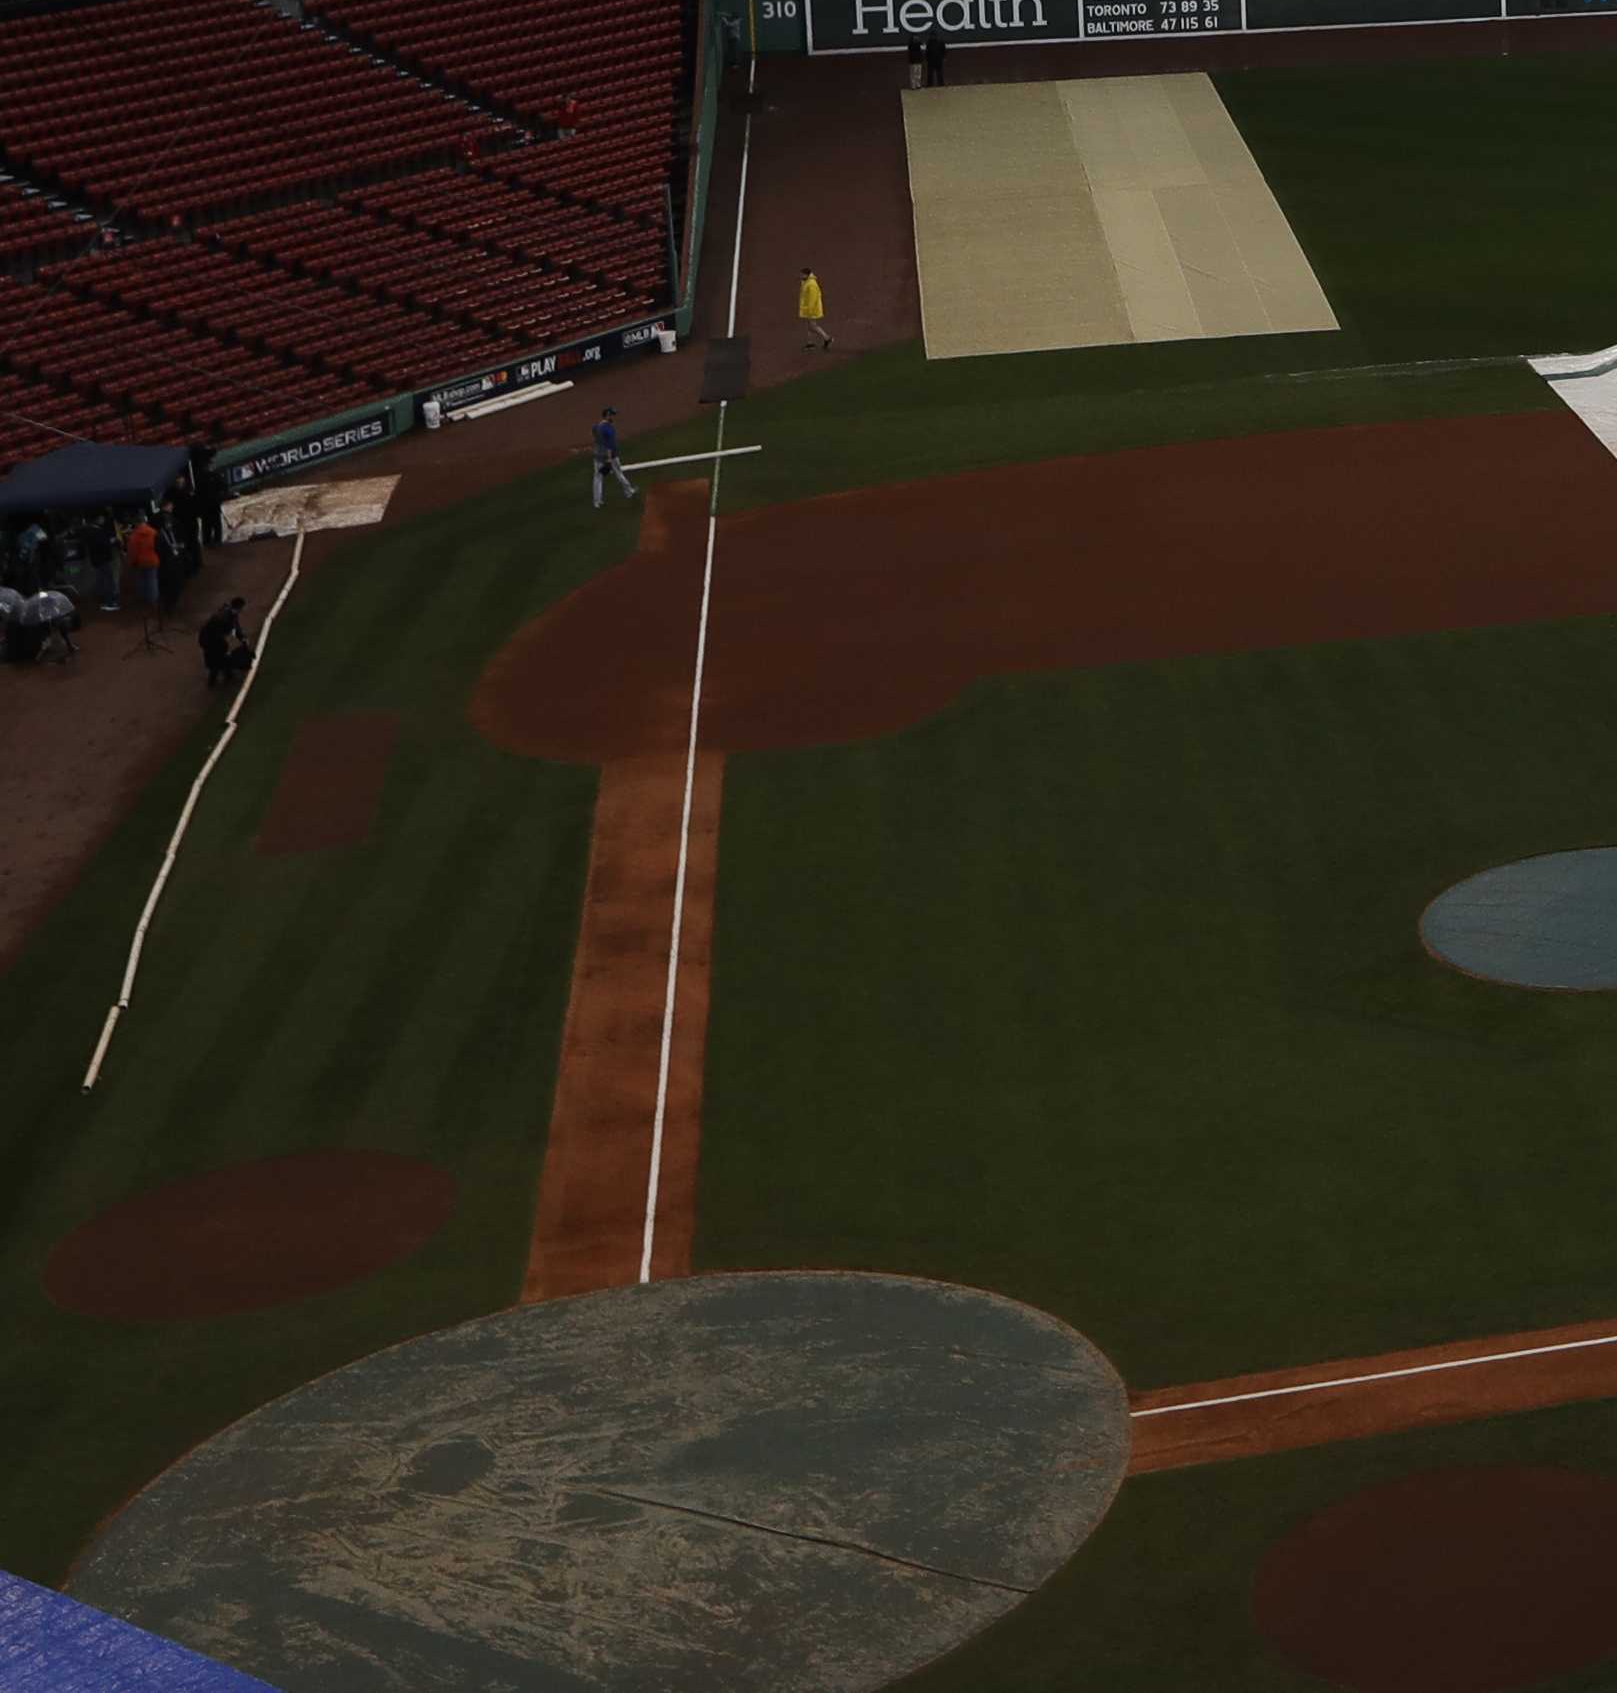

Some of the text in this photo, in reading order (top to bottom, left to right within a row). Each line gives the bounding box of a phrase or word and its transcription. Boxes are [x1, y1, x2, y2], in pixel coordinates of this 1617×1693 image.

[762, 1, 797, 19] 310
[1087, 0, 1219, 17] TORONTO 73 89 35
[1087, 16, 1218, 34] BALTIMORE 47 115 61
[323, 420, 383, 452] SERIES
